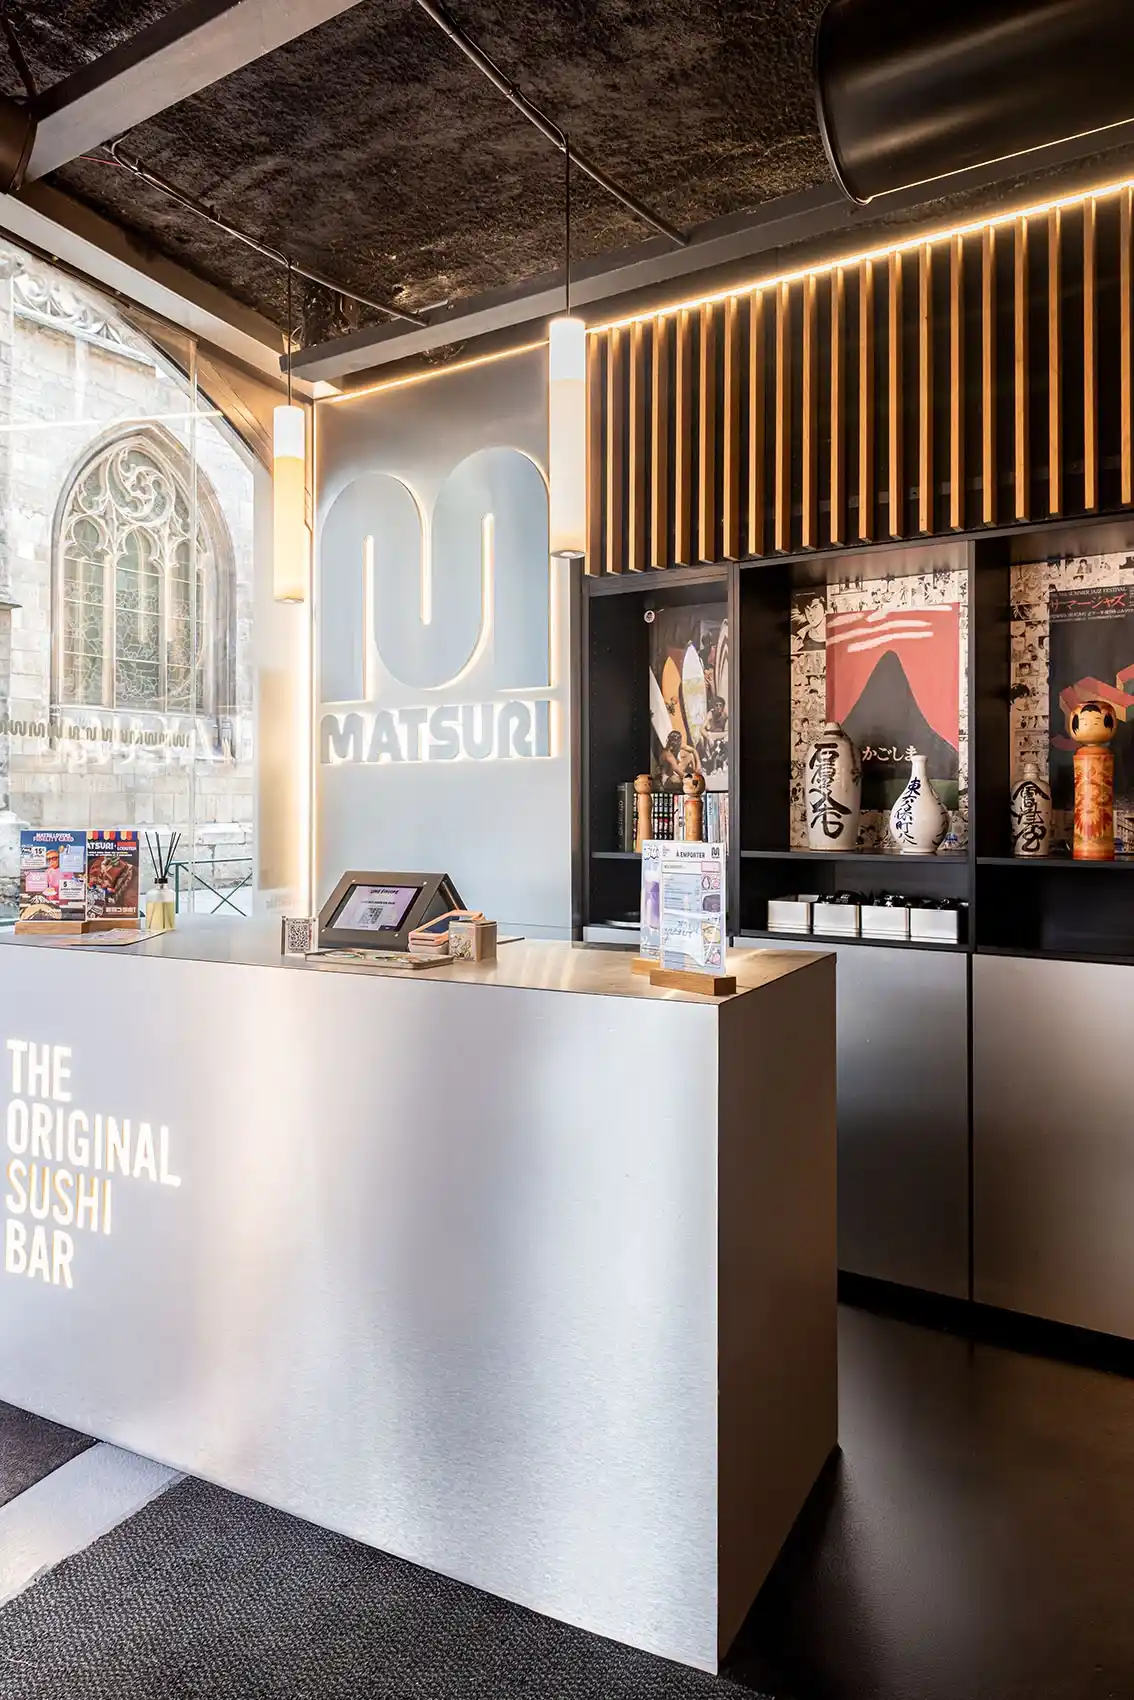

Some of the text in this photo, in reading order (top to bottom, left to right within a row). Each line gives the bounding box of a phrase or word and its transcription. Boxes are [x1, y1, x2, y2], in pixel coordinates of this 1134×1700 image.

[320, 700, 550, 764] MATSURI
[862, 745, 918, 762] かごしま
[87, 842, 114, 850] ATSURI
[680, 851, 706, 859] EMPORTER
[6, 1038, 73, 1103] THE
[6, 1098, 182, 1188] ORIGINAL
[5, 1158, 112, 1236] SUSHI
[5, 1218, 75, 1289] BAR
